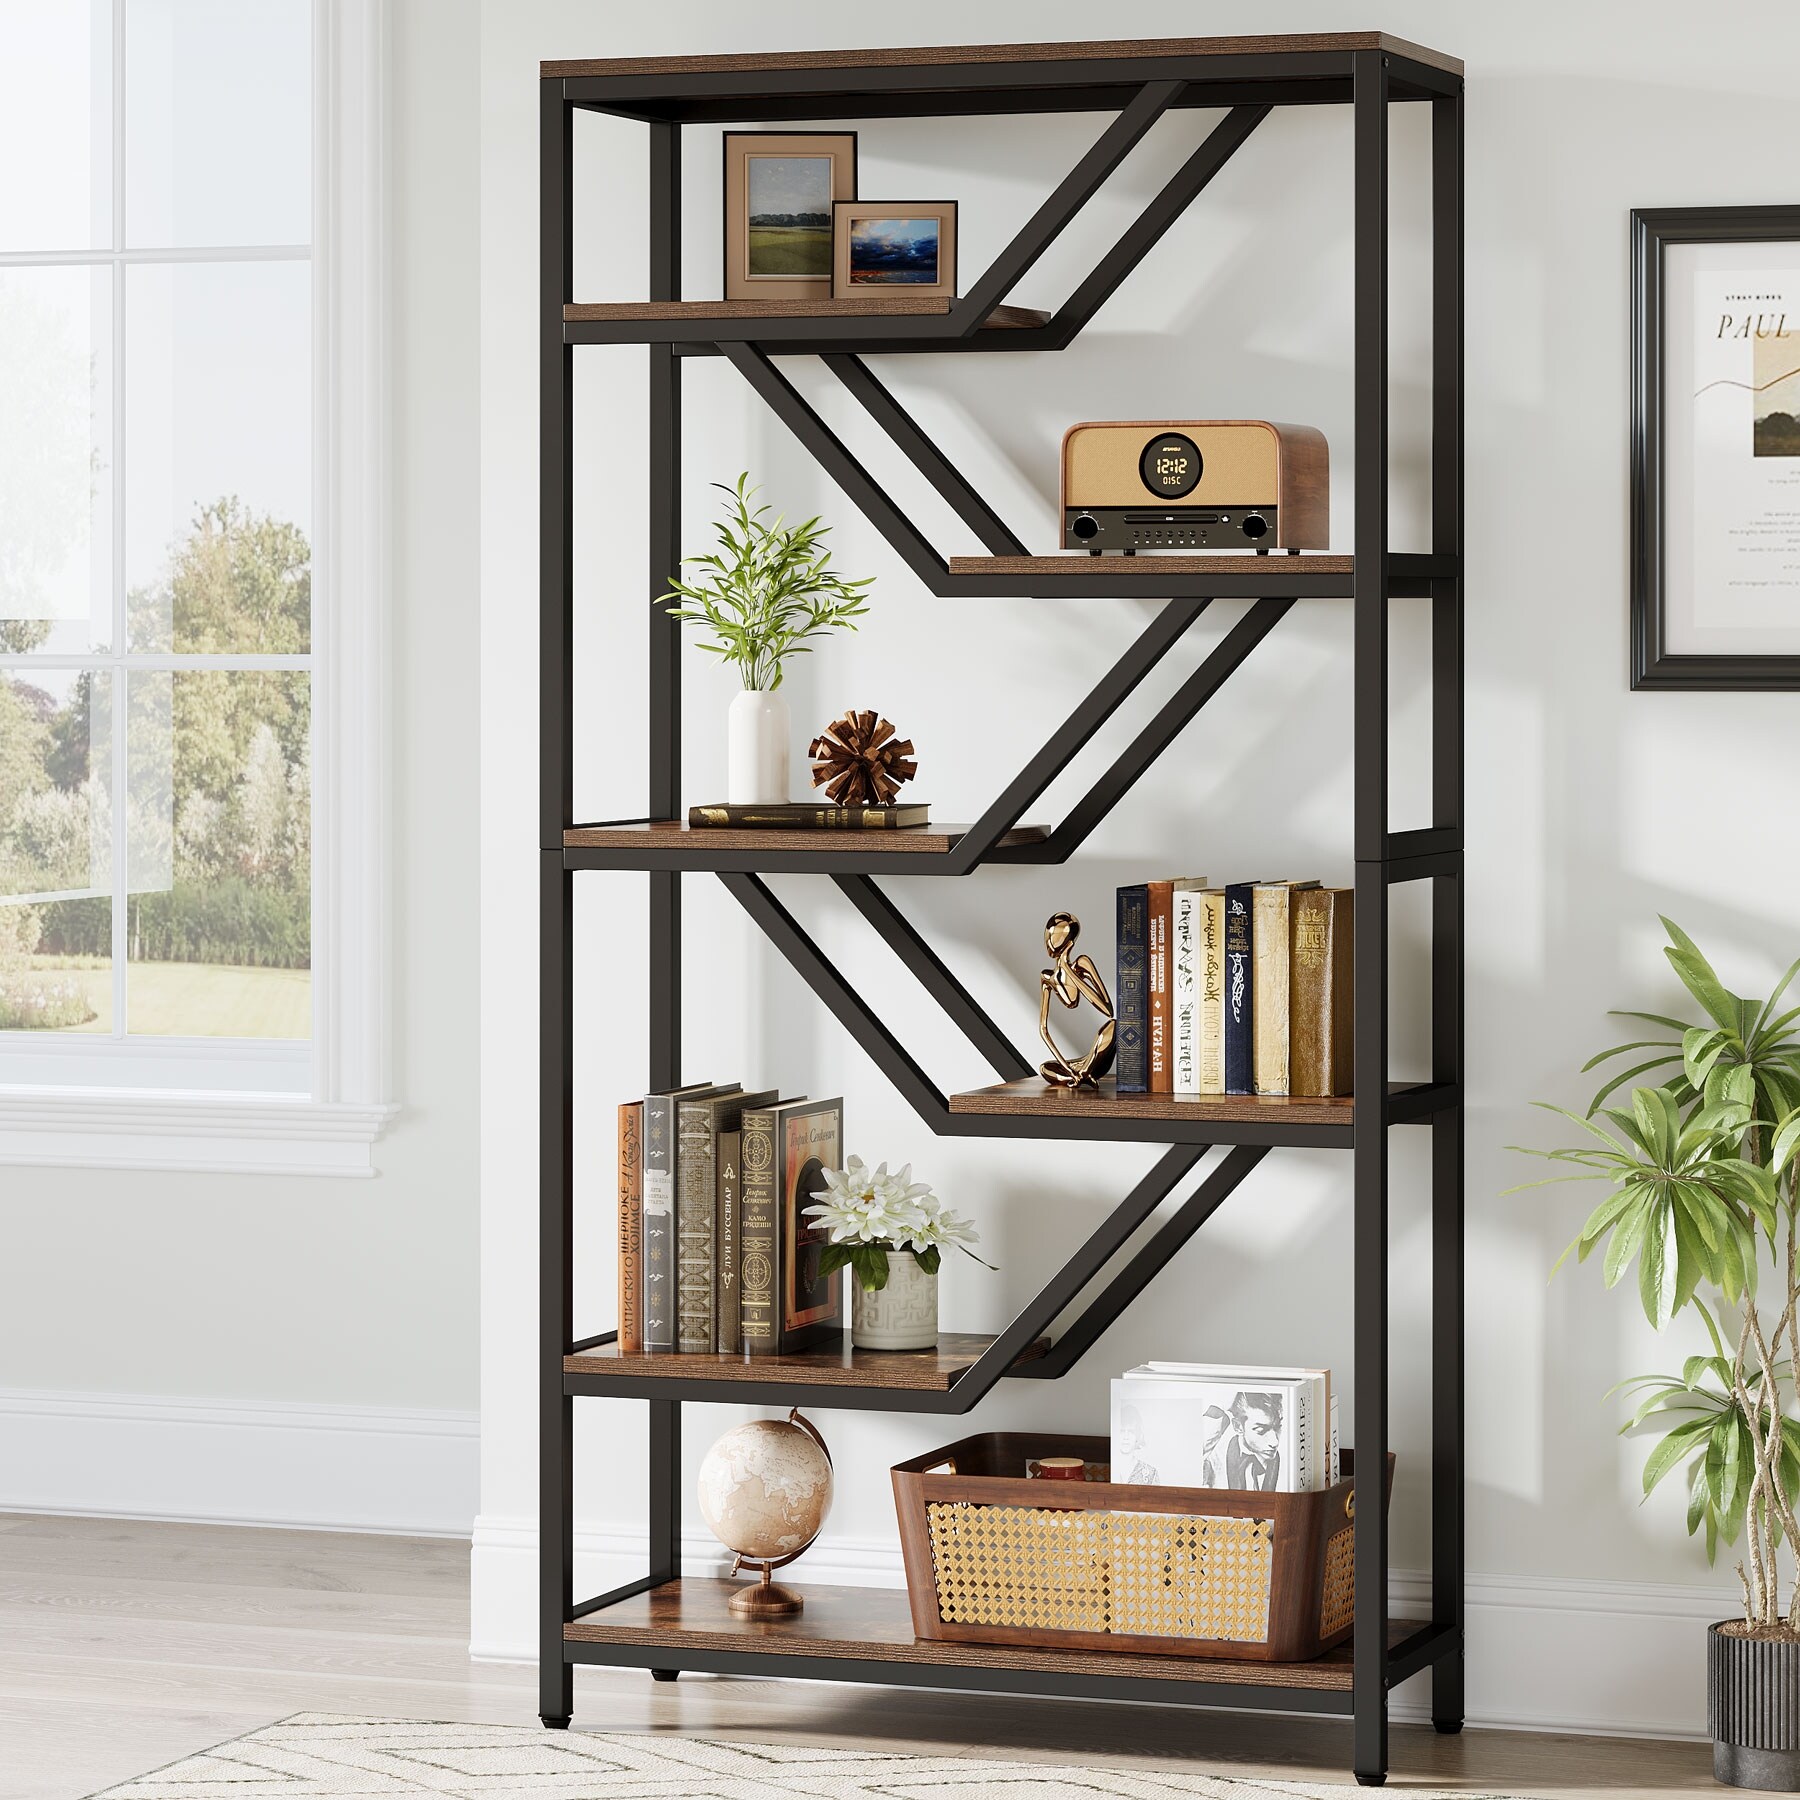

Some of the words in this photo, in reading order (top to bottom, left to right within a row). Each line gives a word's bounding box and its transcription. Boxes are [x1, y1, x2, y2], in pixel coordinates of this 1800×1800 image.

[1717, 313, 1791, 339] PAUL
[1156, 458, 1188, 475] 12:12
[620, 1186, 630, 1253] ШЕРЛОКЕ
[630, 1194, 640, 1255] ХОЛМСЕ
[724, 1186, 732, 1241] БУССЕНАР
[624, 1256, 634, 1268] О
[724, 1245, 732, 1269] ЛУИ
[624, 1270, 634, 1340] ЗАПИСКИ
